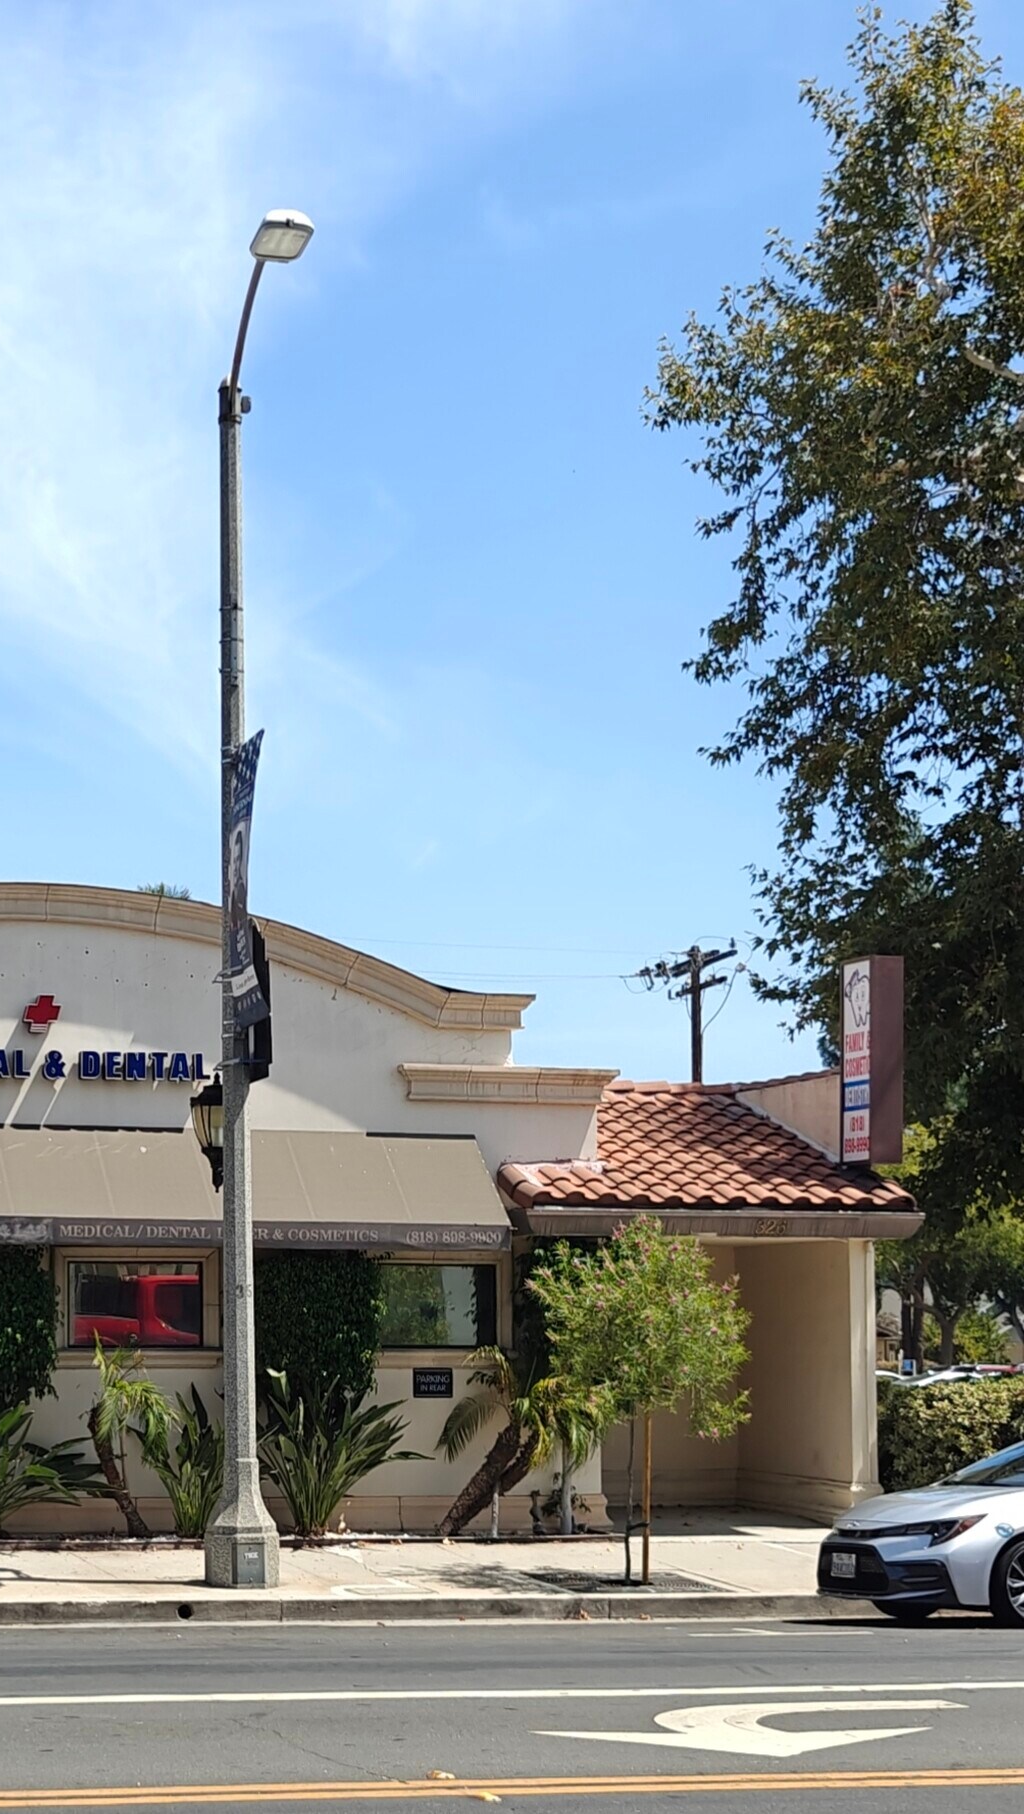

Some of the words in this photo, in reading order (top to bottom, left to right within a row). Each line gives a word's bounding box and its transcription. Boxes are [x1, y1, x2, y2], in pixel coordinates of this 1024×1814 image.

[845, 1031, 865, 1053] FAMILY
[44, 1049, 66, 1080] &
[78, 1050, 211, 1082] DENTAL
[272, 1228, 285, 1240] &
[287, 1228, 379, 1242] COSMETICS
[406, 1231, 438, 1244] (818)
[416, 1374, 450, 1383] PARKING
